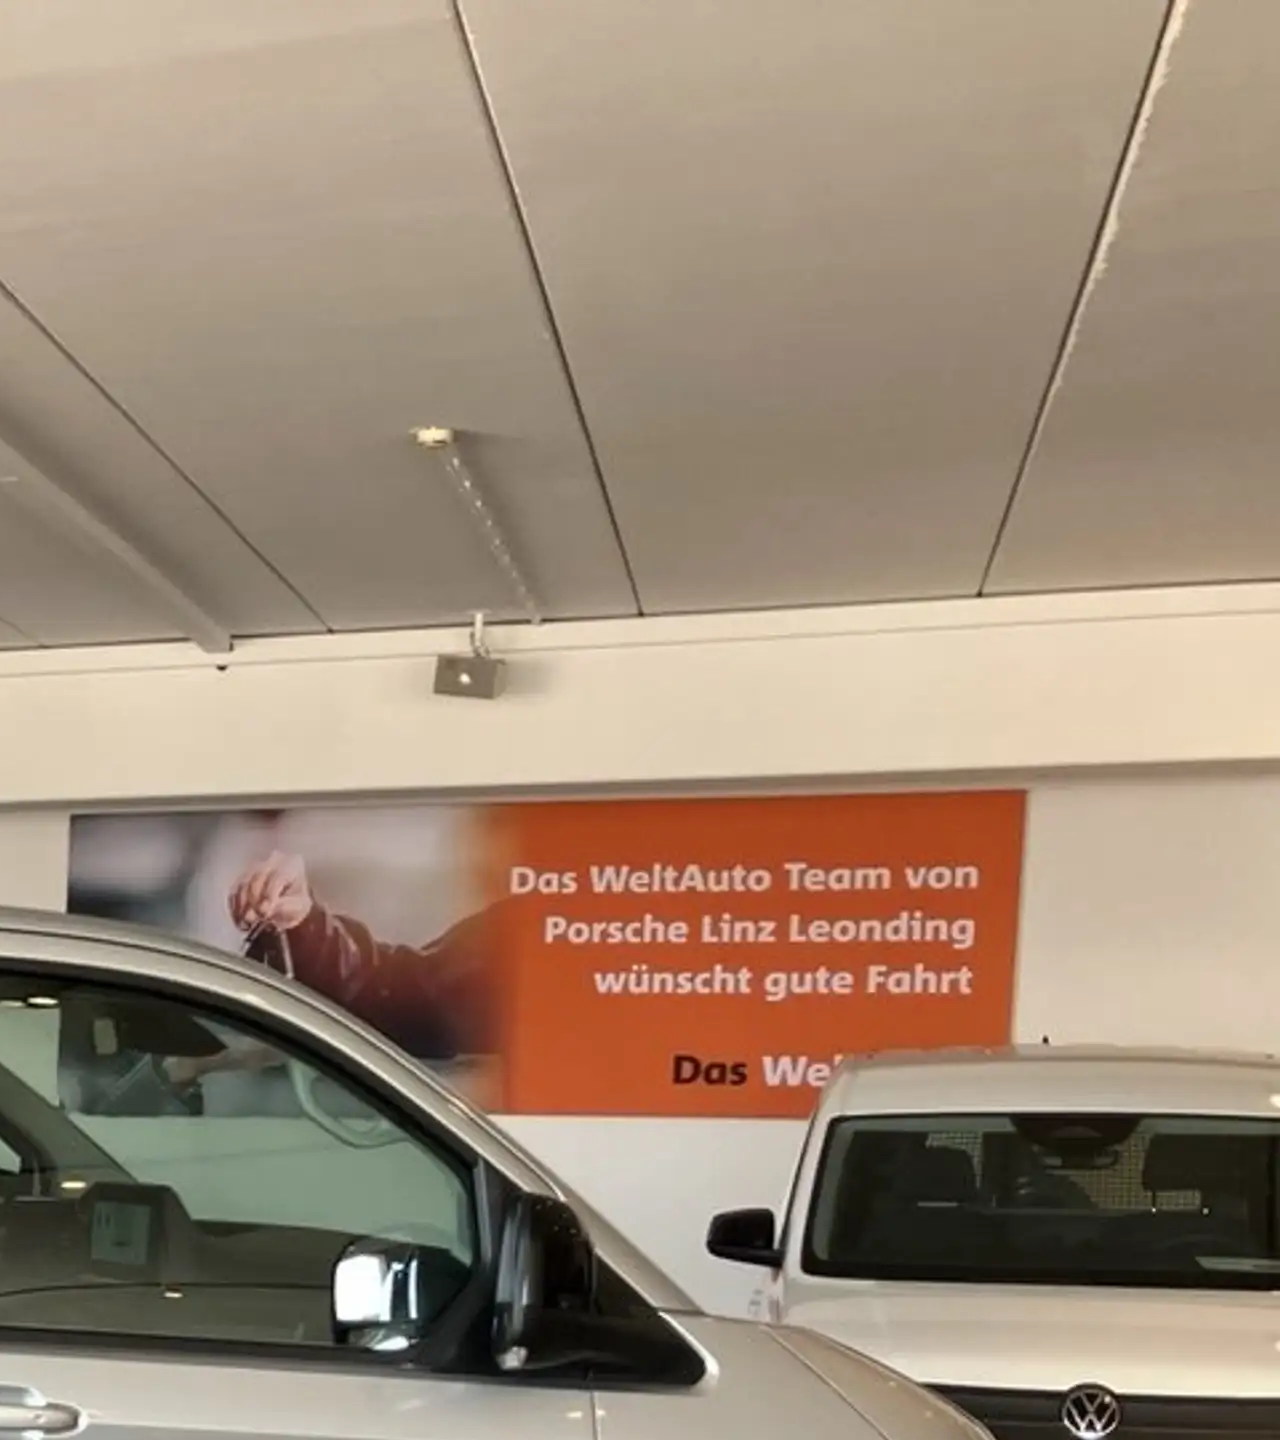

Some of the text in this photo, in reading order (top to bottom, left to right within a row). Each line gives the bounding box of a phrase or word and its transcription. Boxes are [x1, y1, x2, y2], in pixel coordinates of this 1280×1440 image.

[510, 862, 979, 894] Das WeltAuto Team von
[544, 910, 975, 949] Porsche Linz Leonding
[594, 963, 973, 1002] wünscht gute Fahrt
[673, 1054, 843, 1087] Das We
